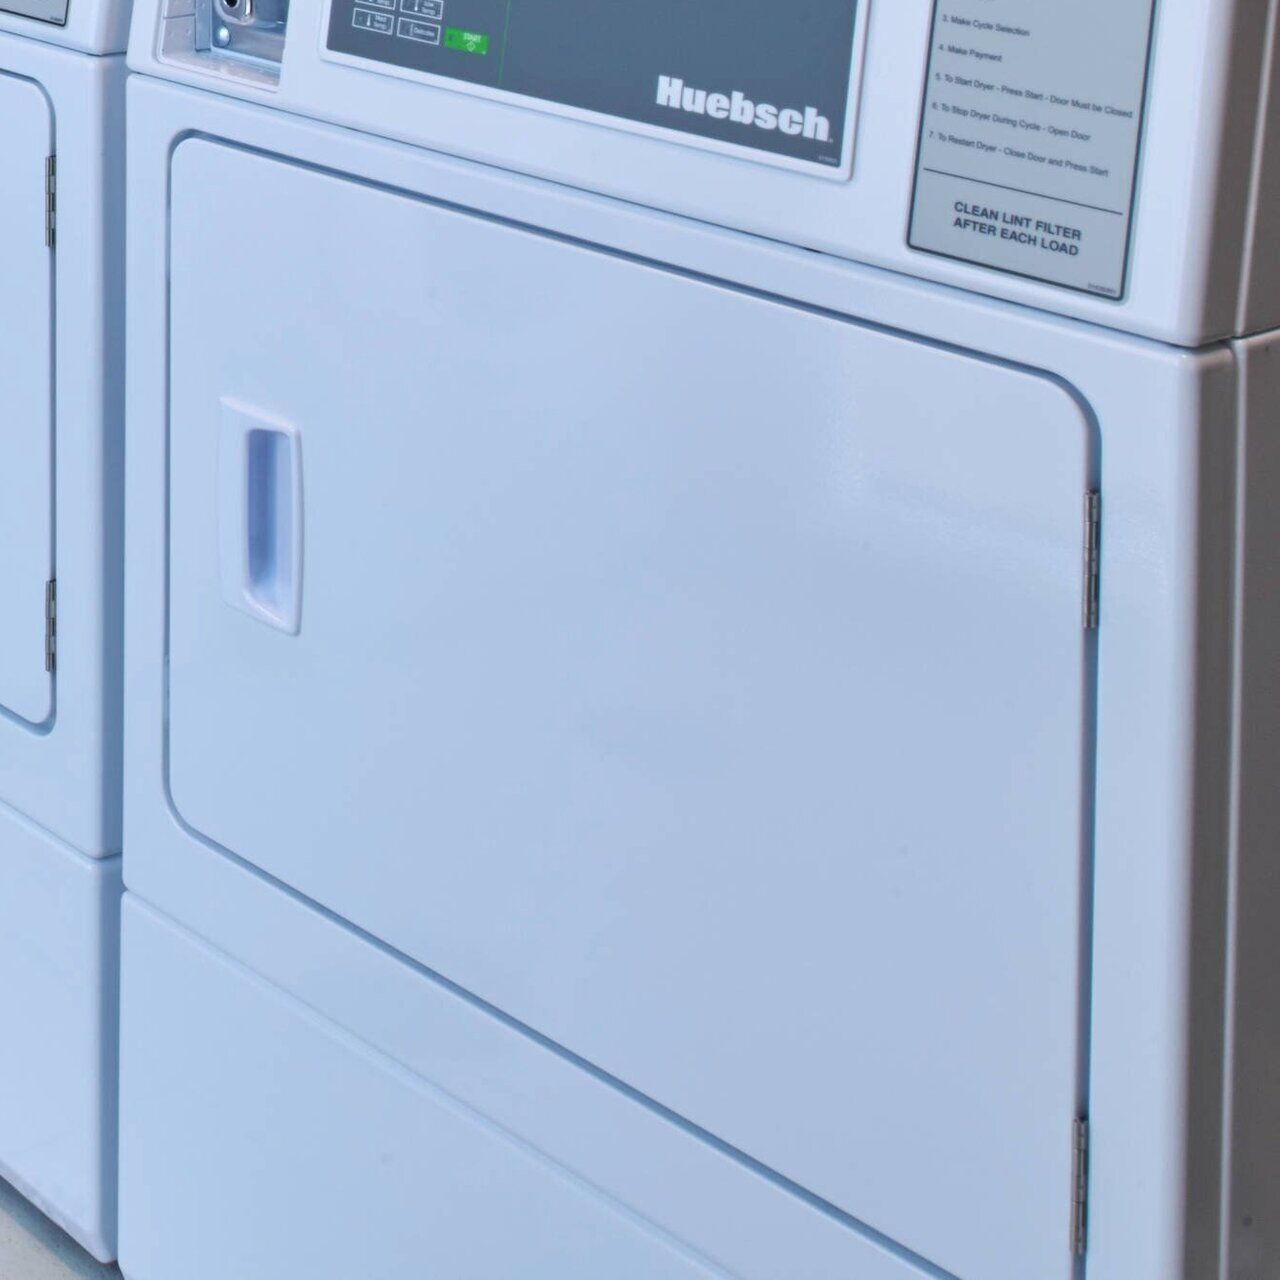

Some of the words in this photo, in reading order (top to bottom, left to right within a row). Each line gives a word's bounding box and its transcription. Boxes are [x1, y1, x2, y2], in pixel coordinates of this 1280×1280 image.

[950, 15, 971, 26] Make
[973, 19, 994, 31] Cycle
[995, 23, 1030, 37] Selection
[947, 44, 968, 56] Make
[969, 48, 1002, 62] Payment
[656, 74, 830, 142] Huebsch
[944, 74, 953, 83] To
[955, 75, 972, 87] Start
[974, 79, 995, 91] Dryer
[1001, 85, 1023, 97] Press
[1025, 90, 1043, 101] Start
[1049, 95, 1069, 106] Door
[1071, 99, 1090, 110] Must
[1092, 103, 1102, 112] be
[1104, 105, 1133, 119] Closed
[941, 103, 950, 112] To
[952, 105, 968, 117] Stop
[970, 109, 991, 121] Dryer
[992, 114, 1017, 127] During
[1019, 119, 1040, 131] Cycle
[1048, 125, 1069, 137] Open
[1071, 130, 1091, 141] Door
[938, 132, 947, 142] To
[948, 134, 975, 148] Restart
[976, 141, 997, 153] Dryer
[1003, 147, 1026, 159] Close
[1027, 152, 1046, 163] Door
[1048, 156, 1063, 167] and
[1065, 160, 1087, 172] Press
[1089, 165, 1109, 177] Start
[953, 217, 996, 236] AFTER
[1000, 228, 1037, 246] EACH
[1041, 239, 1079, 256] LOAD
[954, 201, 999, 221] CLEAN
[1003, 212, 1032, 228] LINT
[1035, 220, 1082, 240] FILTER
